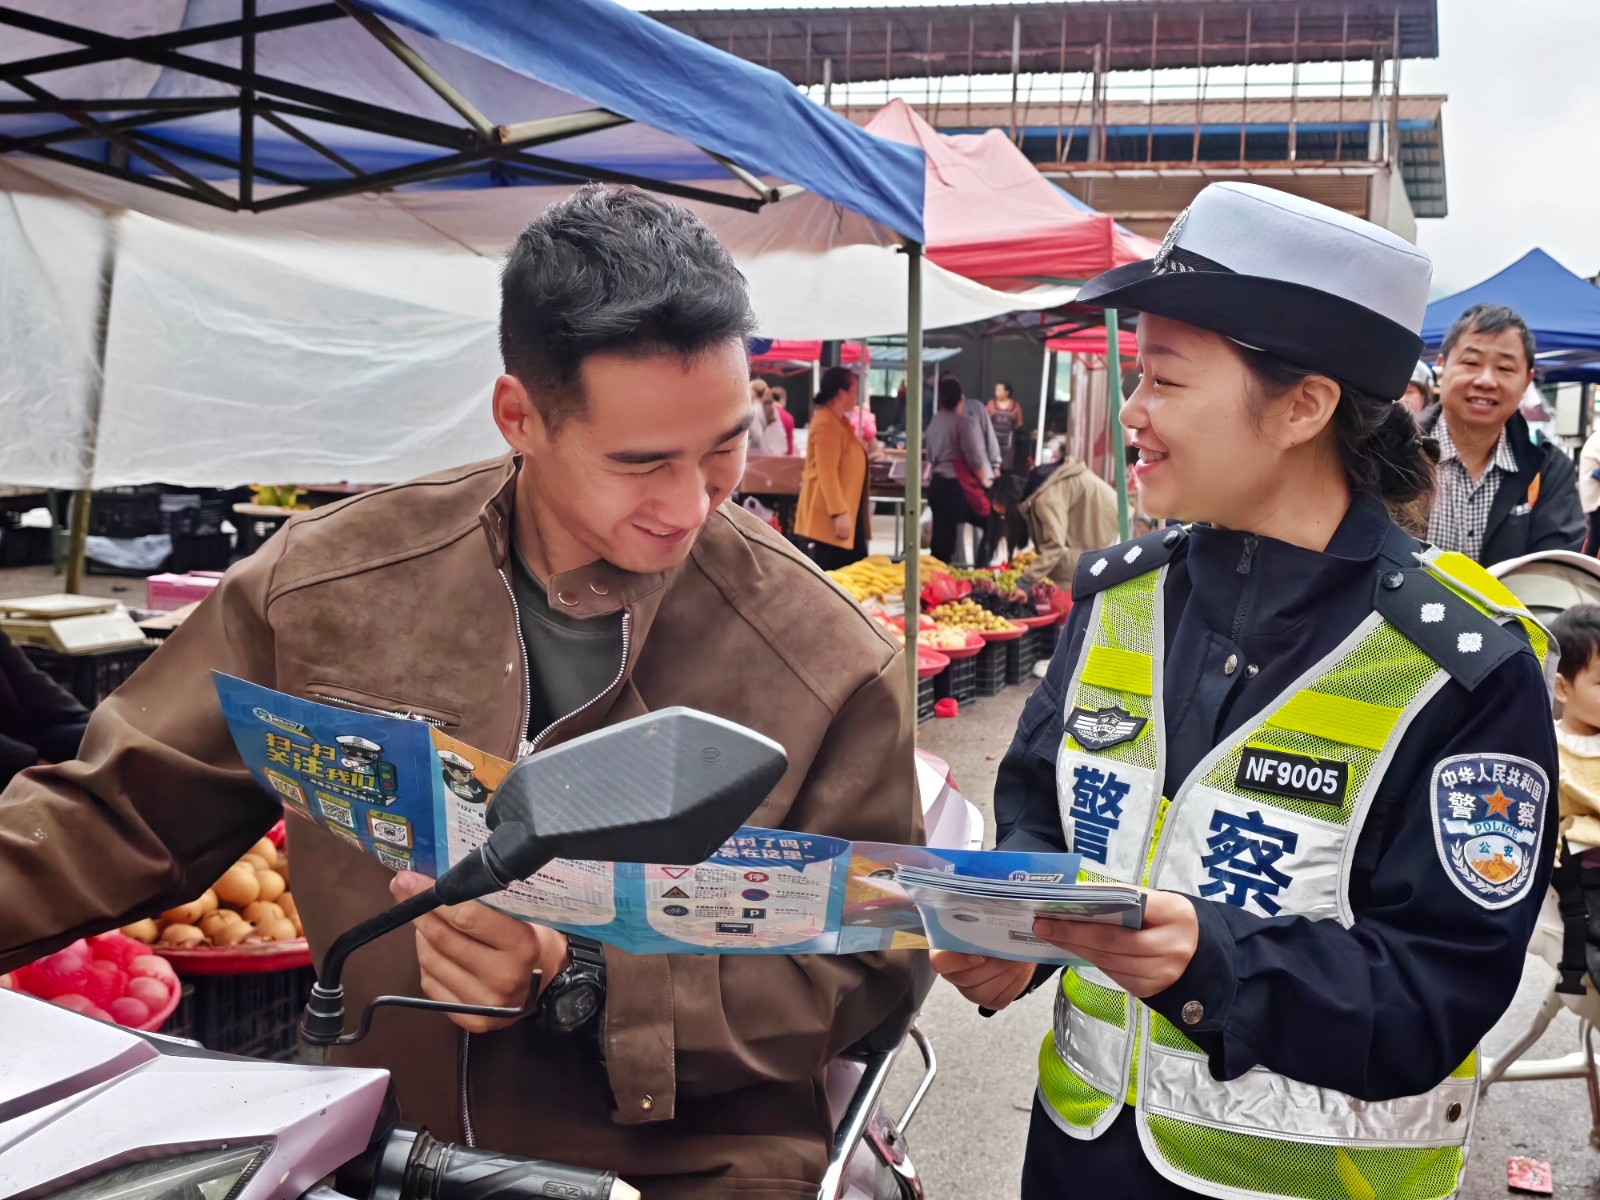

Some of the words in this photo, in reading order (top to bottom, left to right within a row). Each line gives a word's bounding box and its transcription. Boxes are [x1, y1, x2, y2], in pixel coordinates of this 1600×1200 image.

[265, 732, 336, 761] 扫一扫
[265, 747, 376, 788] 关注我们
[1245, 756, 1340, 795] NF9005
[1441, 763, 1542, 803] 中华人民共和国
[1447, 791, 1477, 820] 警
[1517, 801, 1536, 828] 察
[1069, 765, 1132, 865] 警
[1198, 809, 1299, 917] 察
[1473, 819, 1519, 840] POLICE
[750, 909, 760, 918] P
